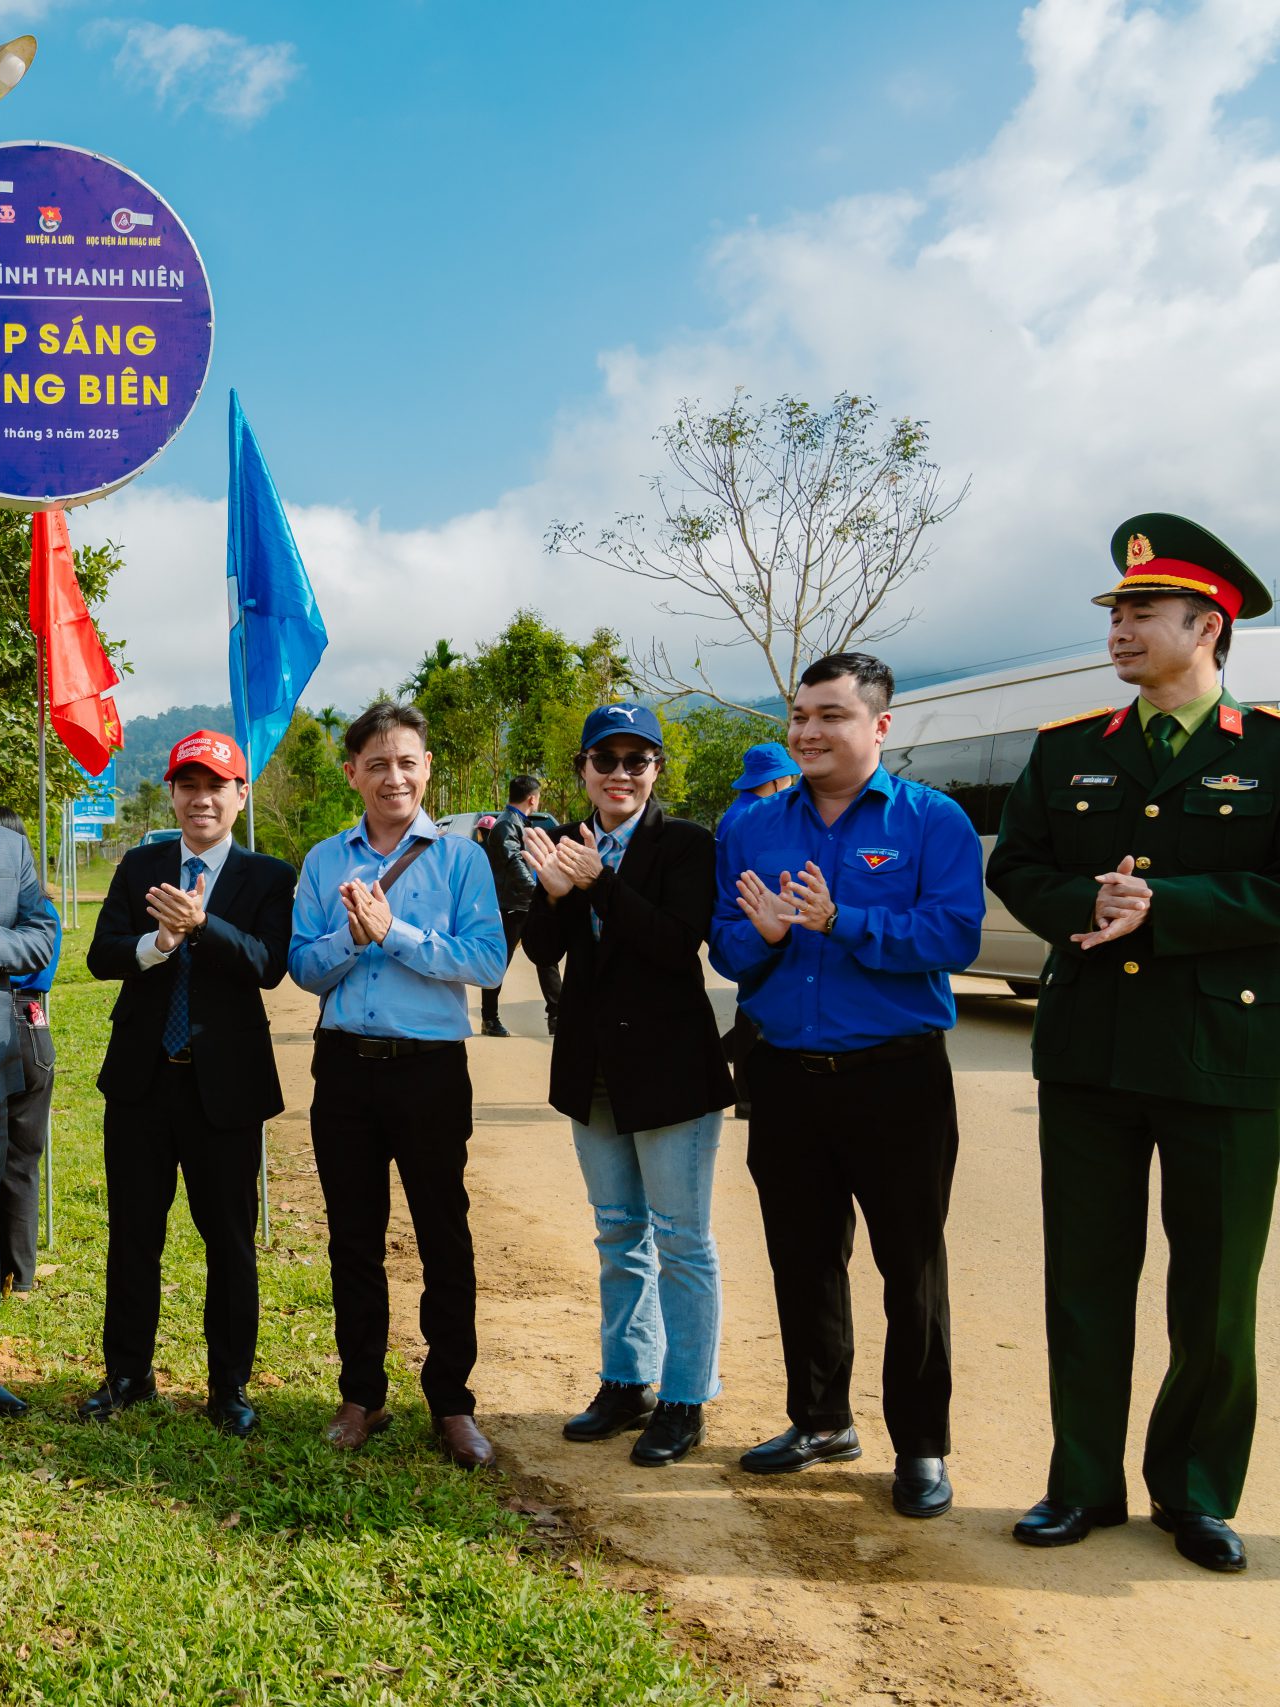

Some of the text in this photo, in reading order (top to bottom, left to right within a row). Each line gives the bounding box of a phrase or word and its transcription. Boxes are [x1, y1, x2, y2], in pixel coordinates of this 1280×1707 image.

[25, 233, 50, 246] HUYỆN
[51, 235, 57, 245] A
[86, 235, 99, 247] HỌC
[100, 235, 116, 247] VIỆN
[129, 236, 147, 248] NHẠC
[44, 267, 124, 287] THANH
[131, 265, 185, 288] NIÊN
[38, 314, 157, 356] SÁNG
[79, 366, 168, 406] BIÊN
[4, 427, 43, 441] tháng
[45, 428, 53, 438] 3
[56, 428, 85, 439] năm
[88, 428, 120, 440] 2025
